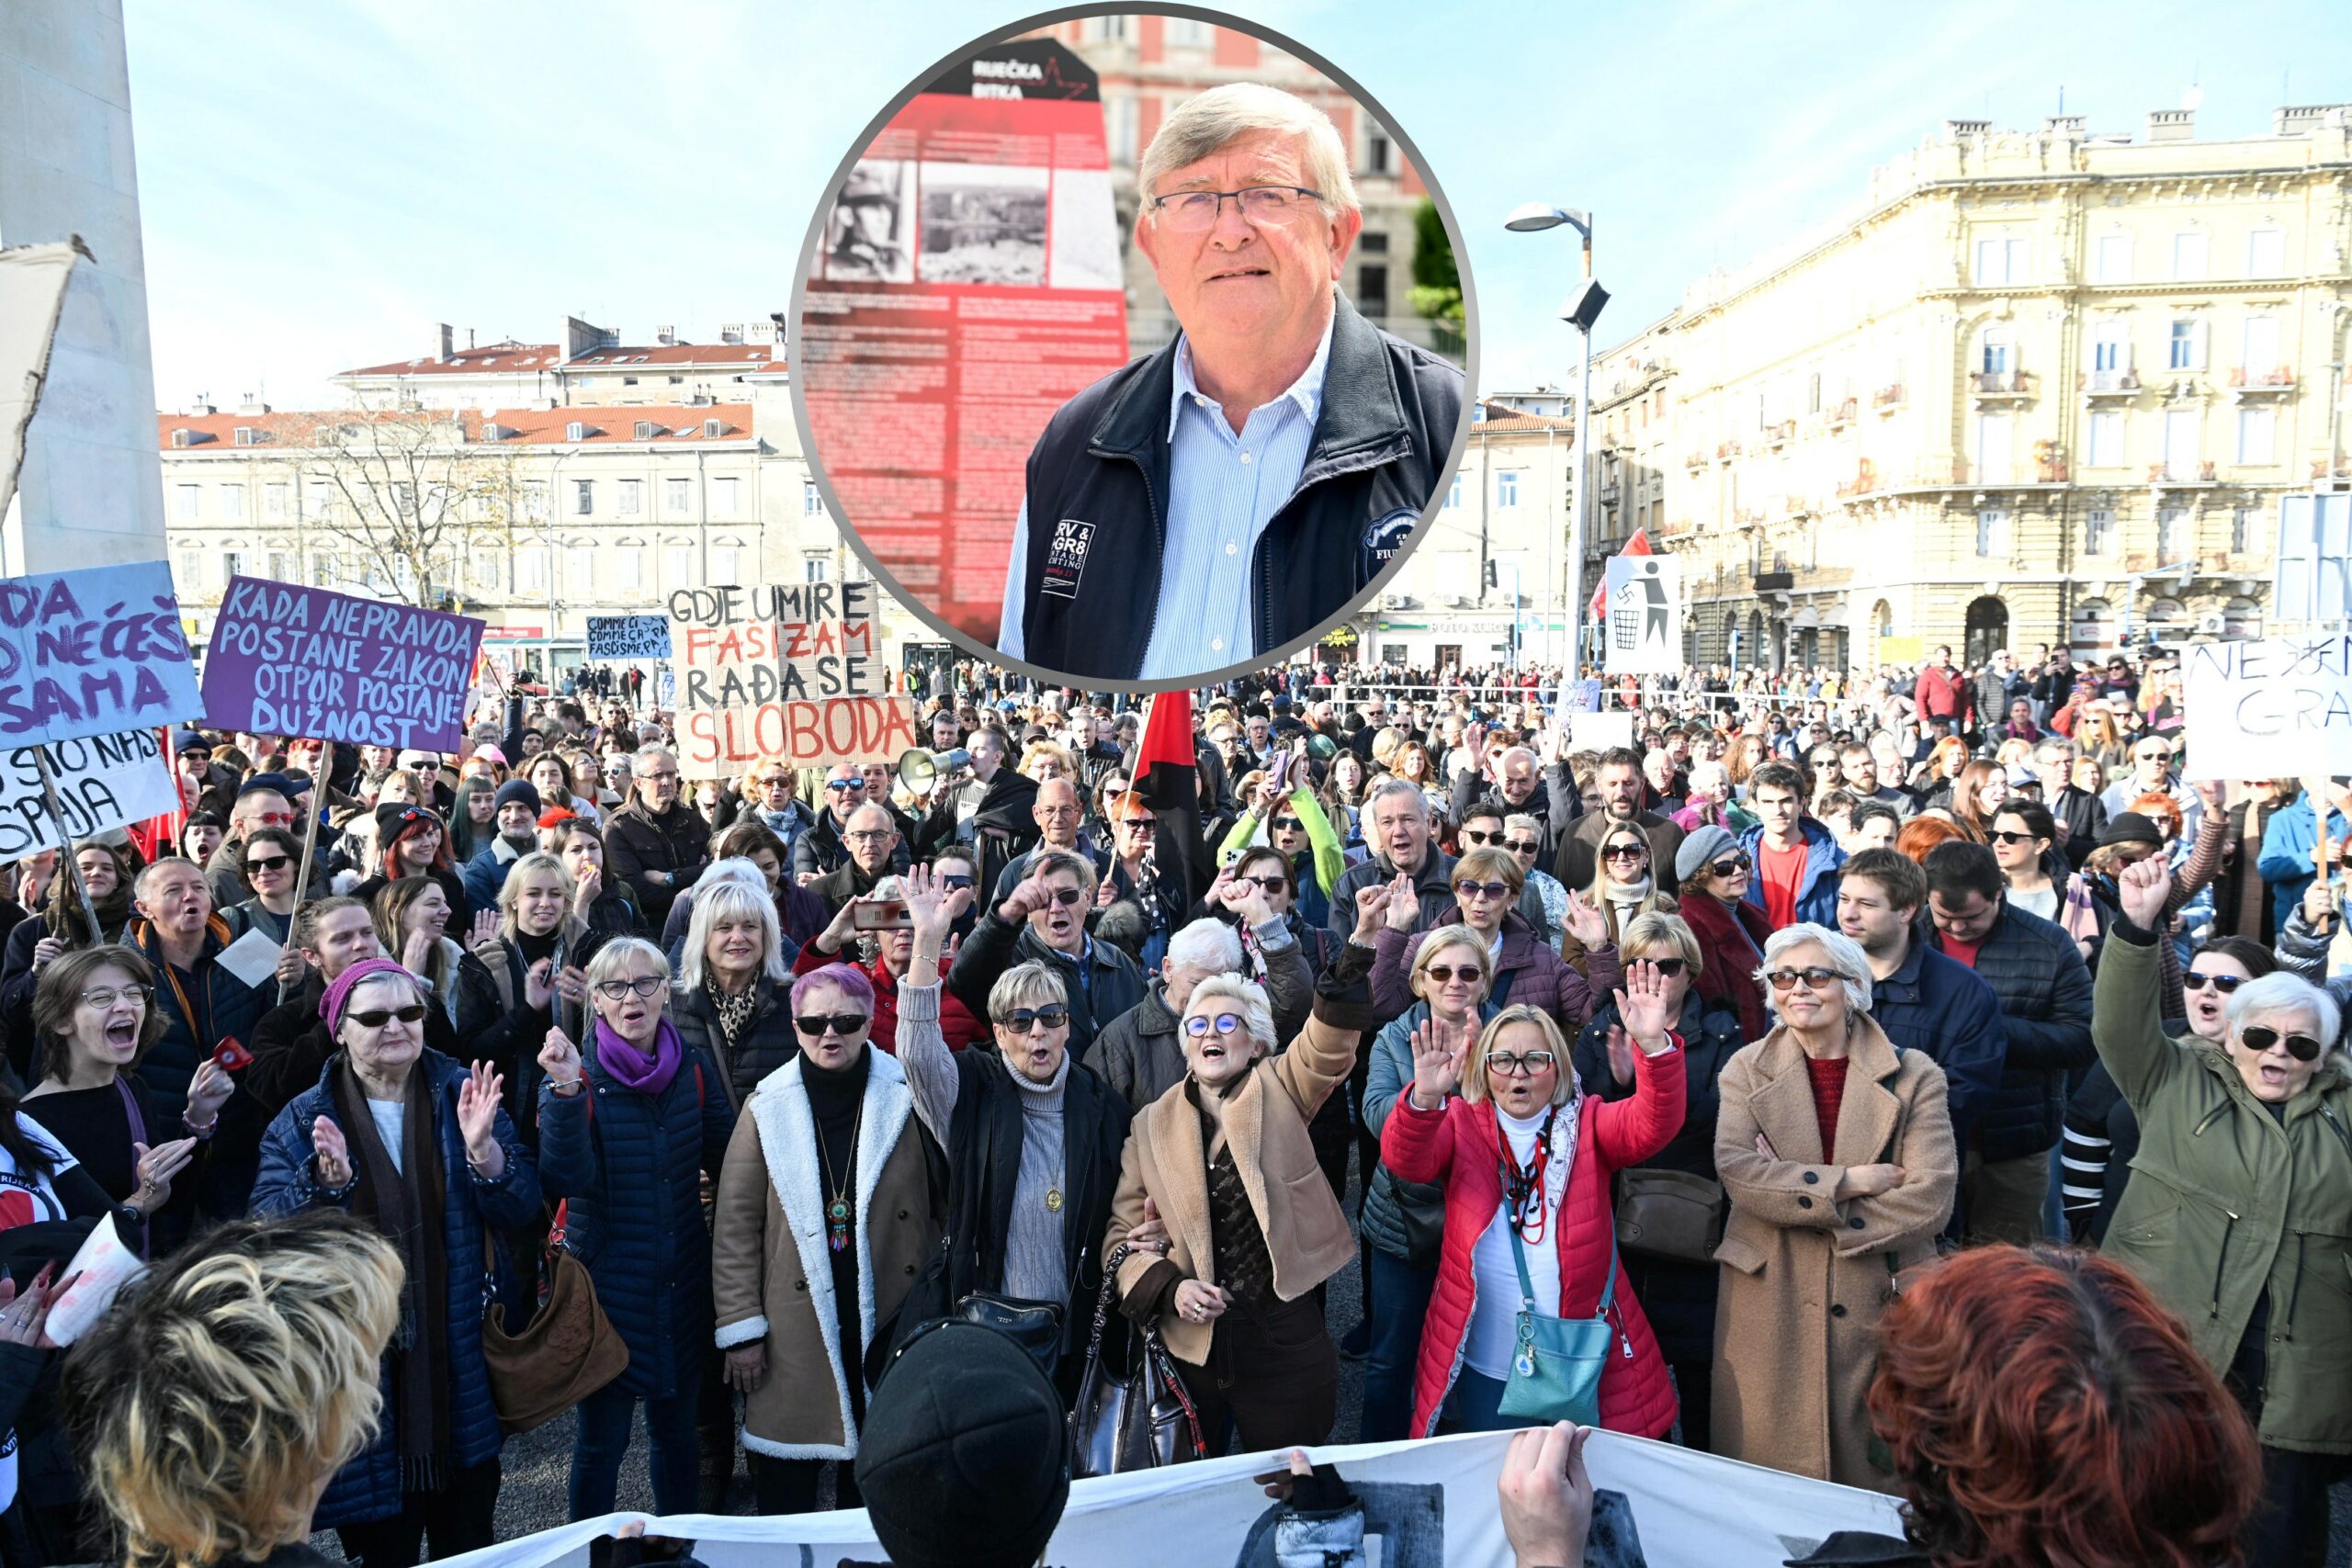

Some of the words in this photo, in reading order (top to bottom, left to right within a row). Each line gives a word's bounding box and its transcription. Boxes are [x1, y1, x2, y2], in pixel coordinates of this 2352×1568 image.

[1079, 527, 1090, 541] &
[228, 582, 309, 627] KADA
[320, 599, 470, 659] NEPRAVDA
[588, 617, 626, 631] COMME
[669, 585, 743, 627] GDJE
[752, 582, 872, 625] UMIRE
[220, 621, 364, 672] POSTANE
[370, 646, 469, 694] ZAKON
[589, 630, 626, 642] COMME
[686, 618, 872, 665] FAŠIZAM
[687, 663, 808, 711] RAĐA
[817, 656, 868, 695] SE
[2188, 642, 2267, 682] NE
[0, 664, 172, 733] SAMA
[254, 662, 345, 707] OTPOR
[356, 676, 463, 734] POSTAJE
[251, 697, 419, 749] DUŽNOST
[690, 694, 916, 762] SLOBODA
[1, 1175, 40, 1193] RIJEKA
